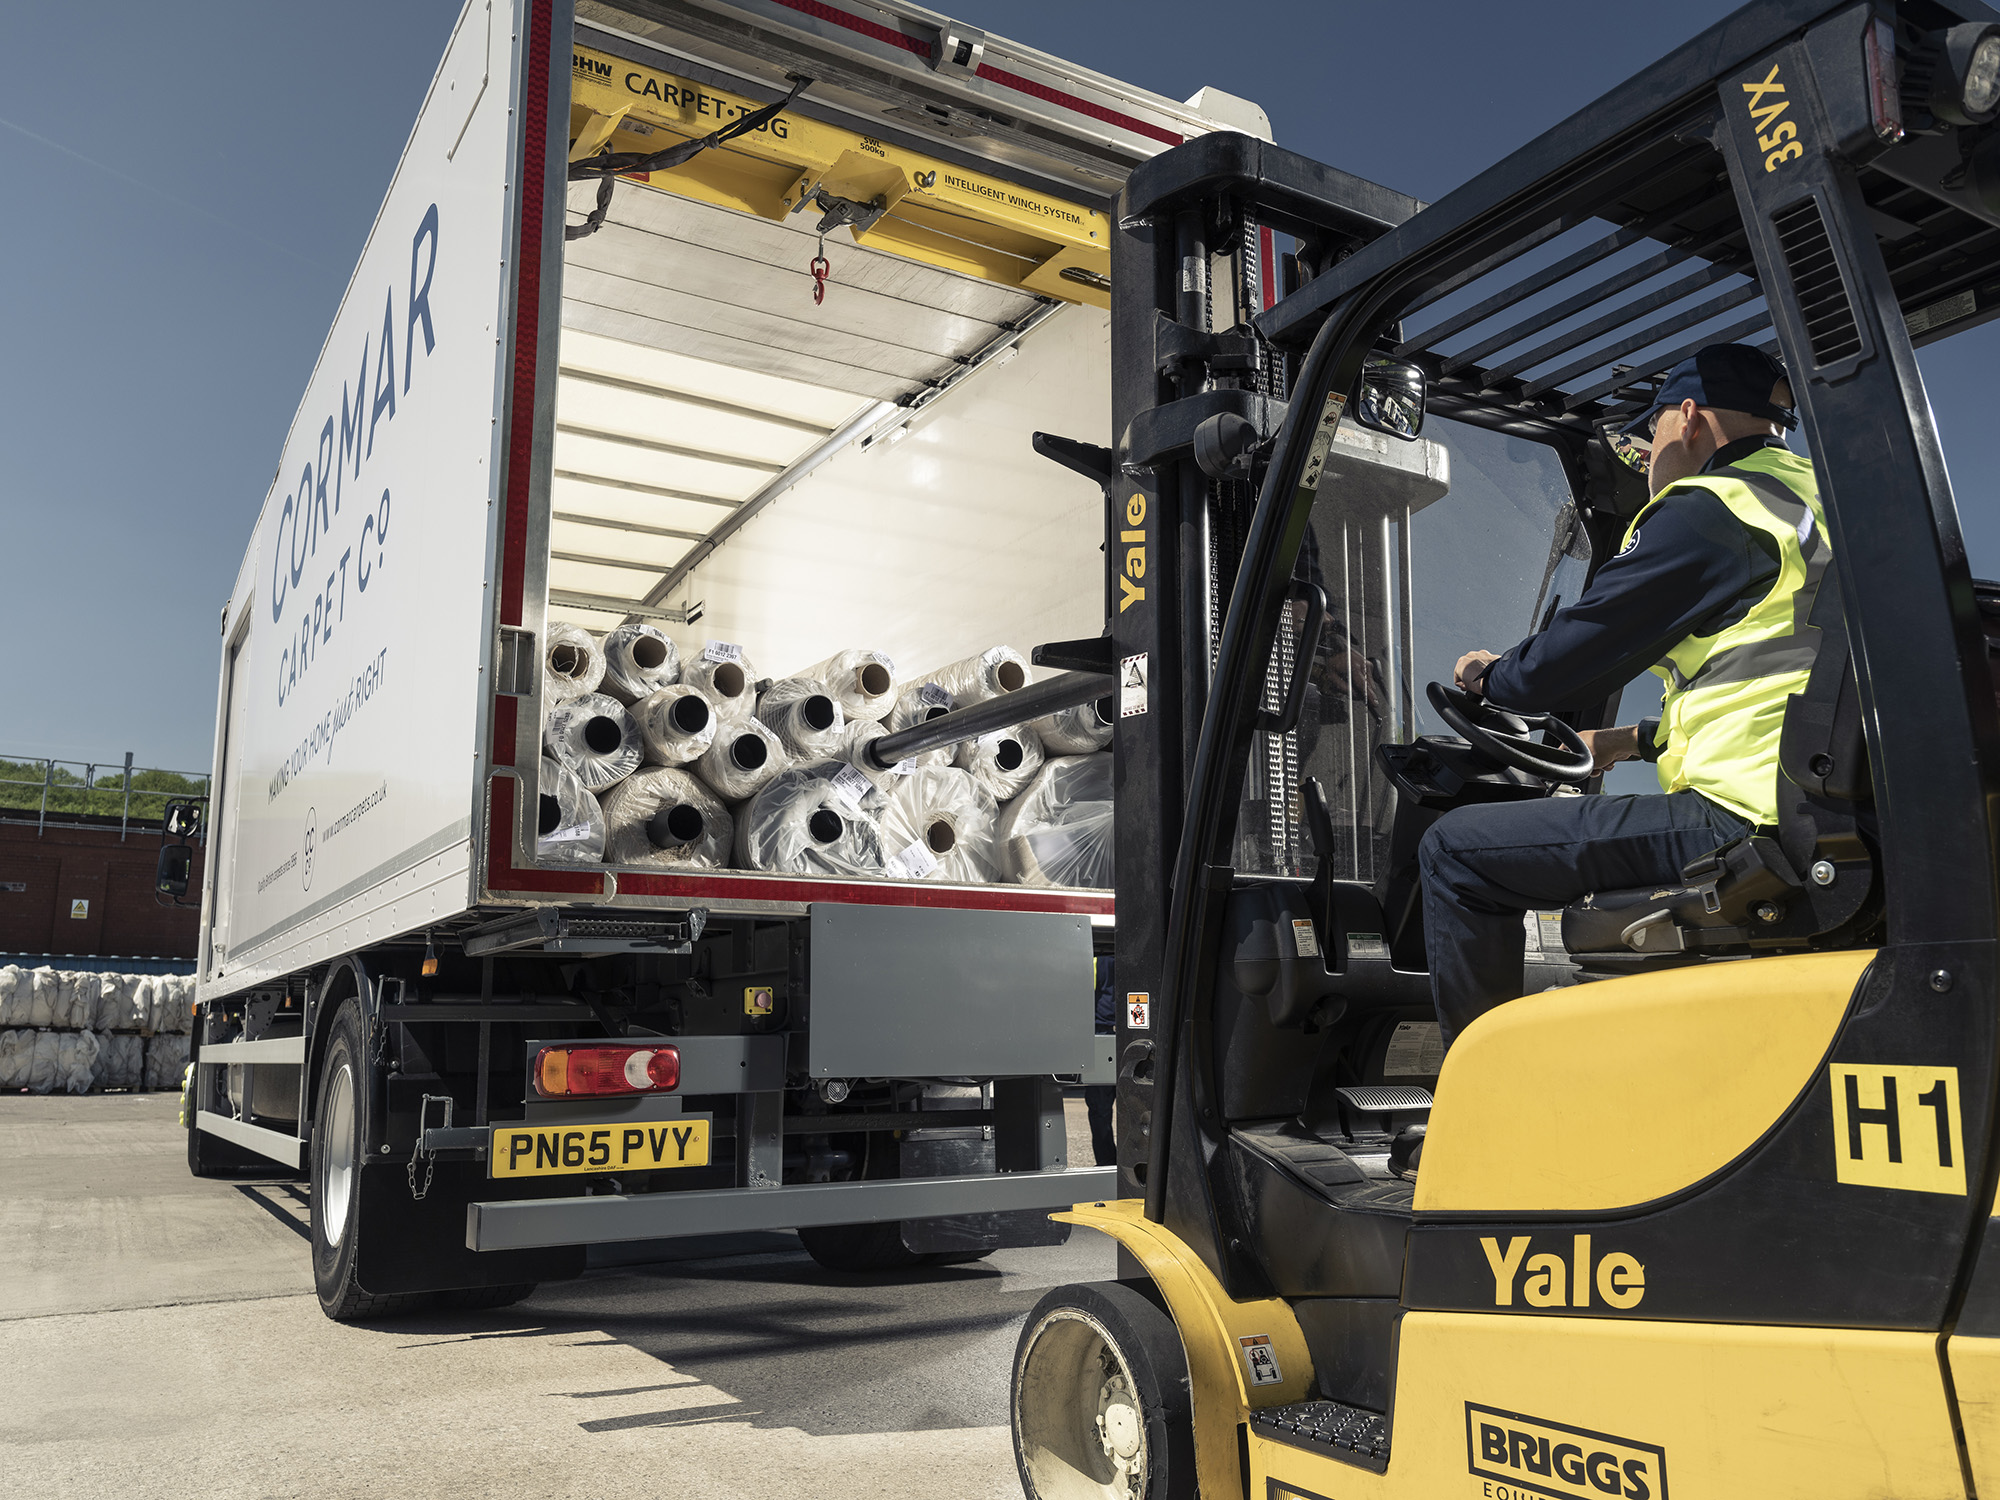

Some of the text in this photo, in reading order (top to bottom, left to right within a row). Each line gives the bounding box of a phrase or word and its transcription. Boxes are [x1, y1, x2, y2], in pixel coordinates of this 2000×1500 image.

[860, 142, 885, 157] 500kg
[863, 136, 881, 148] SWL
[1742, 63, 1803, 173] 35VX
[944, 174, 1006, 201] INTELLIGENT
[1007, 194, 1041, 212] WINCH
[1043, 205, 1081, 225] SYSTEM
[272, 202, 439, 624] CORMAR
[1120, 493, 1147, 614] Yale
[278, 545, 350, 708] CARPET
[268, 759, 290, 805] MAKING
[291, 738, 308, 780] YOUR
[309, 710, 331, 761] HOME
[355, 647, 387, 712] RIGHT
[509, 1126, 693, 1170] PN65 PVY
[1844, 1074, 1953, 1168] H1
[1479, 1234, 1645, 1310] Yale
[1480, 1422, 1650, 1500] BRIGGS
